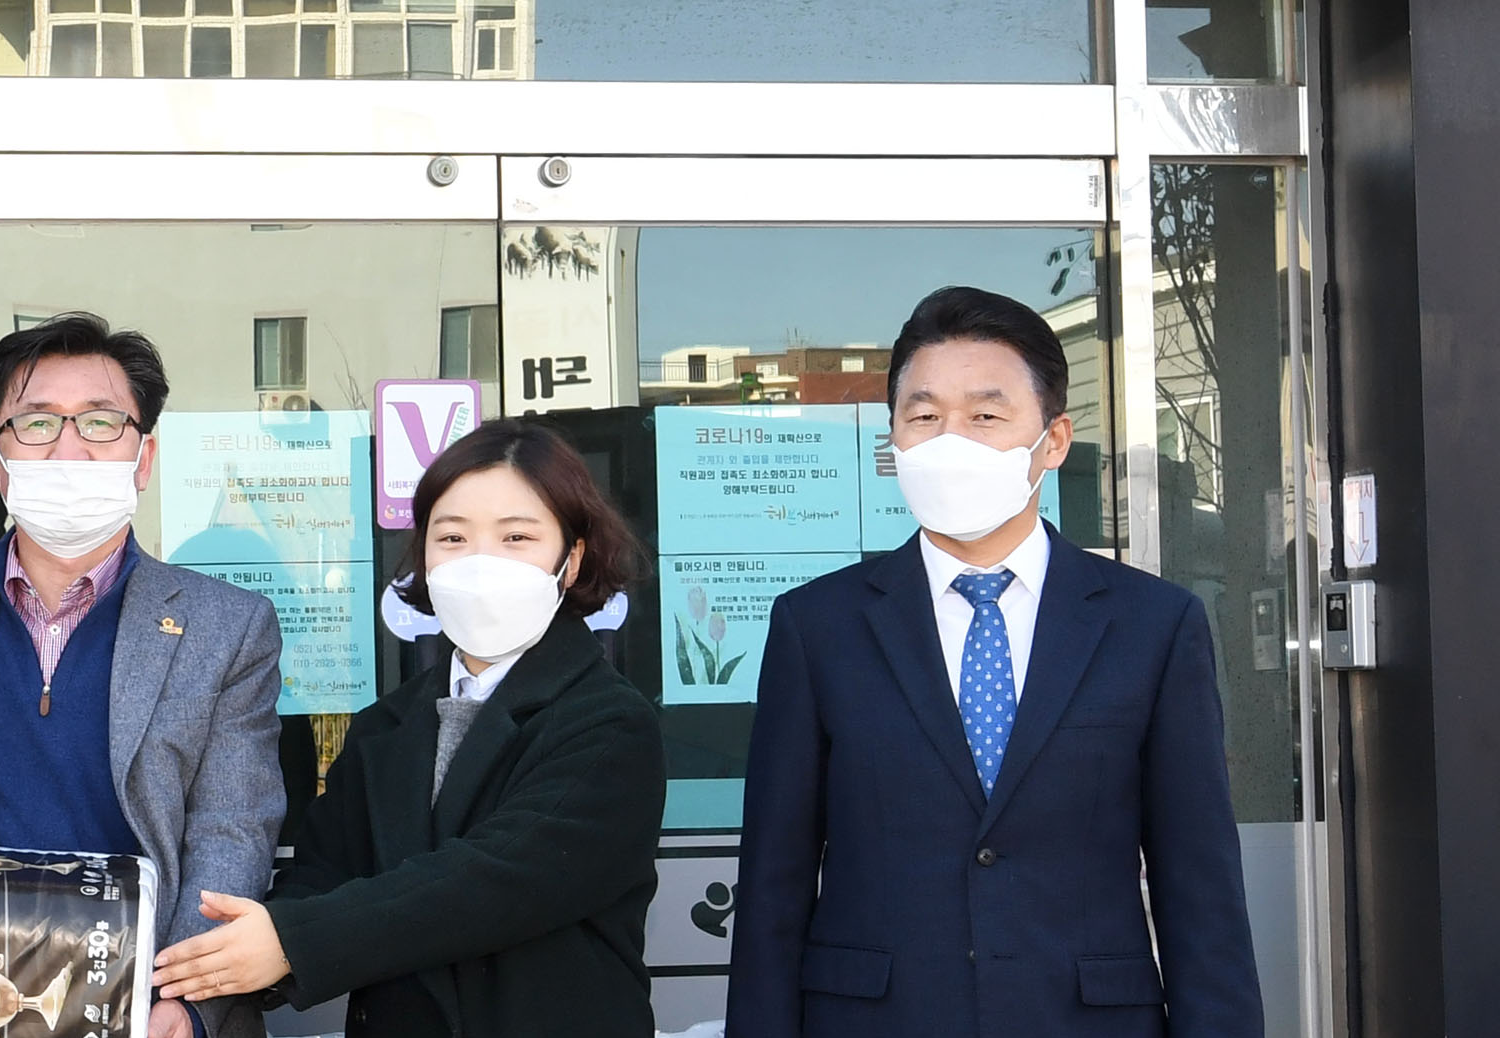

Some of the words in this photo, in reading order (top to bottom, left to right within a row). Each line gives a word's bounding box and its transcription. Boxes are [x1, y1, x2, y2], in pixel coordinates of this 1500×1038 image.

[695, 428, 772, 444] 코로나19의
[778, 433, 822, 443] 재확산으로
[680, 470, 715, 480] 직원과의
[721, 470, 747, 480] 접촉도
[753, 469, 806, 480] 최소화하고자
